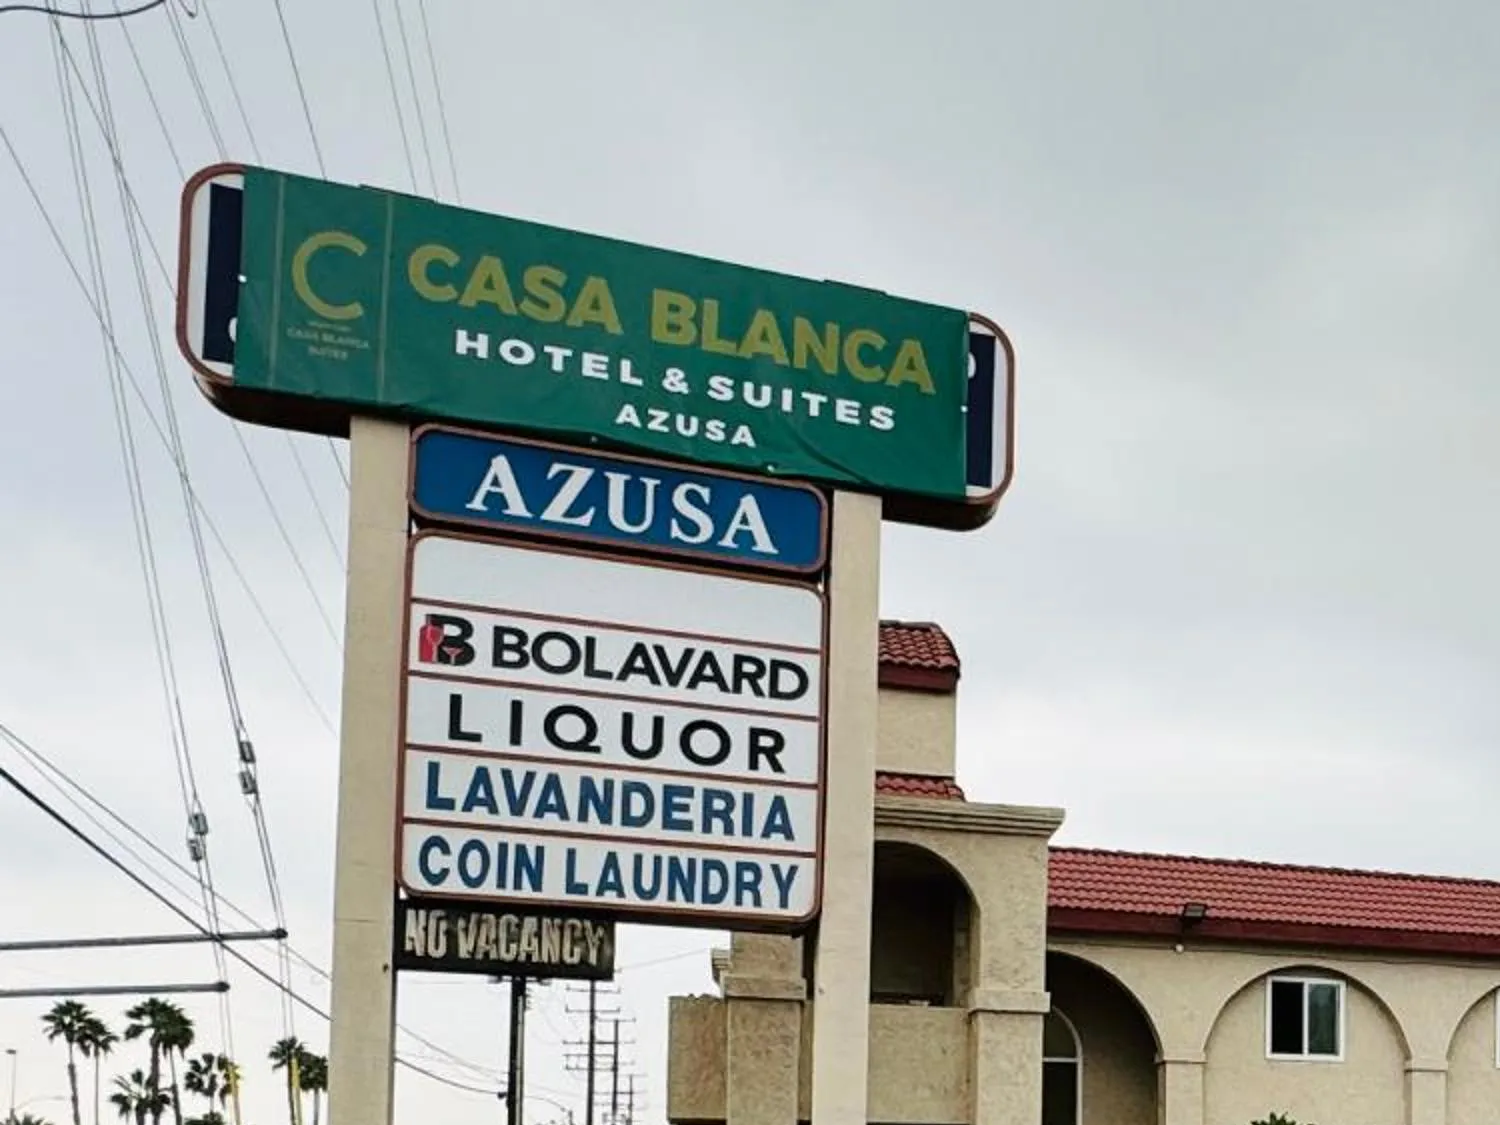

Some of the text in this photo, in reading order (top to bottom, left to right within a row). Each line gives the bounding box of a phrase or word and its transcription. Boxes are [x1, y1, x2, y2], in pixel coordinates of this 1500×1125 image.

[291, 231, 366, 320] C
[408, 244, 936, 394] CASA BLANCA
[456, 329, 895, 430] HOTEL & SUITES
[616, 403, 757, 449] AZUSA
[466, 454, 779, 554] AZUSA
[492, 624, 809, 701] BOLAVARD
[447, 693, 786, 774] LIQUOR
[425, 760, 796, 842] LAVANDERIA
[418, 835, 799, 910] COIN LAUNDRY
[404, 908, 606, 966] NO VACANCY
